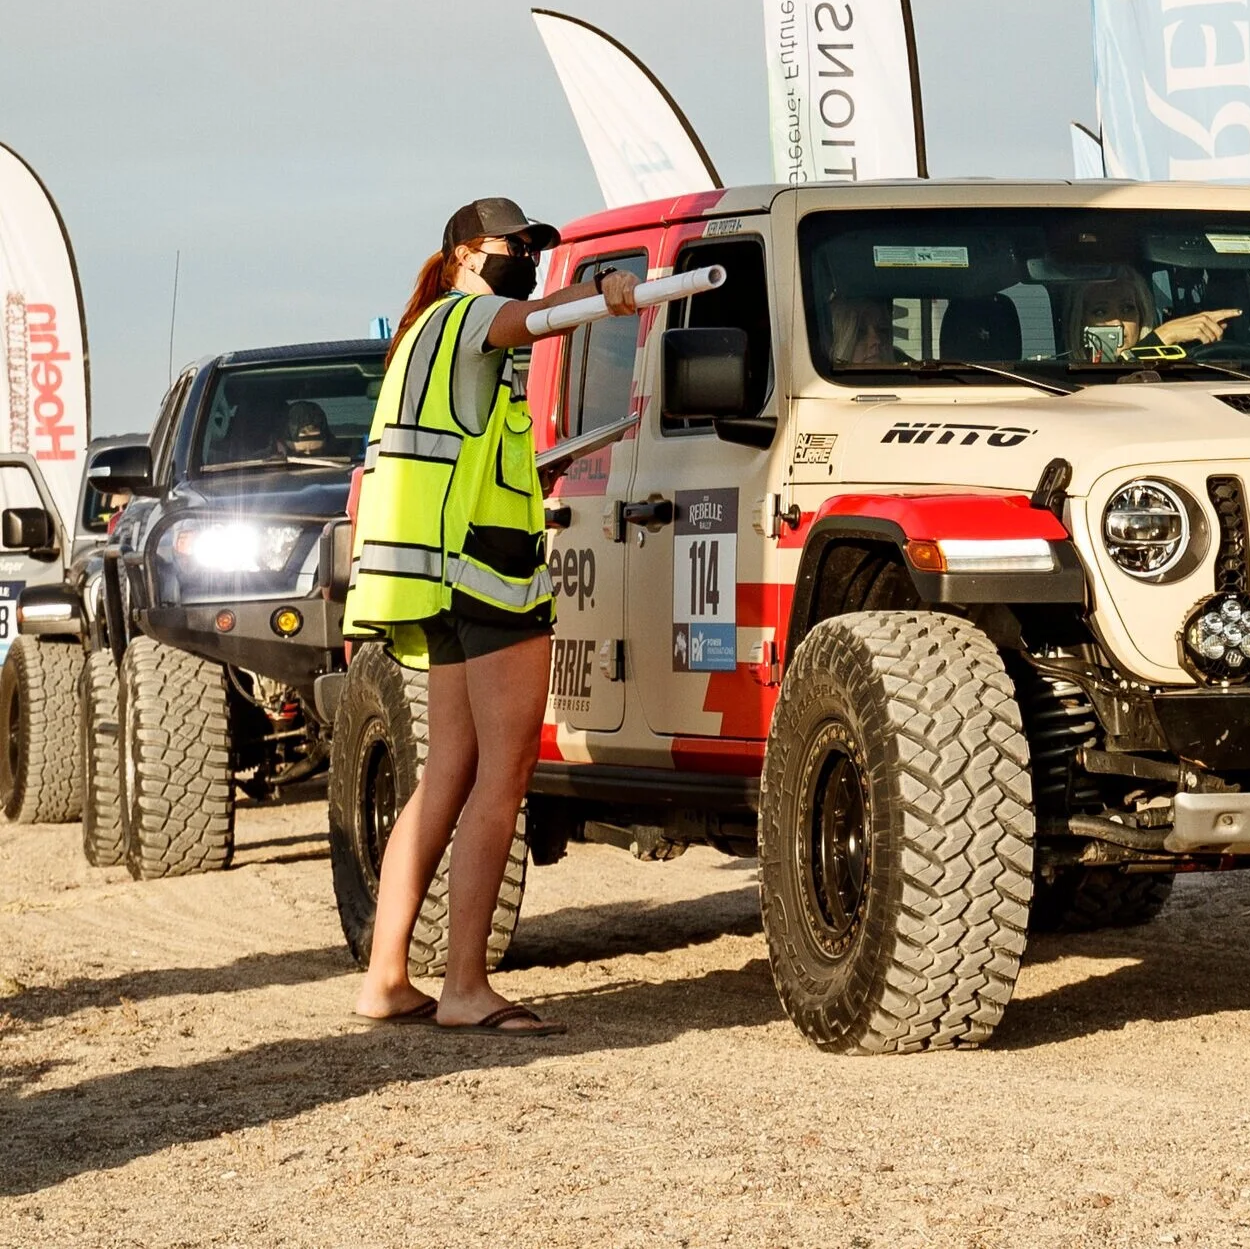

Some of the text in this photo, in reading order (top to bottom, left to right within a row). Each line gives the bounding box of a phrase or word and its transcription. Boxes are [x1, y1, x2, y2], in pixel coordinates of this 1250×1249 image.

[880, 422, 1033, 448] NITTO
[689, 502, 723, 526] REBELLE
[689, 540, 719, 615] 114
[551, 639, 596, 698] RRIE
[549, 697, 591, 713] TERPRISES
